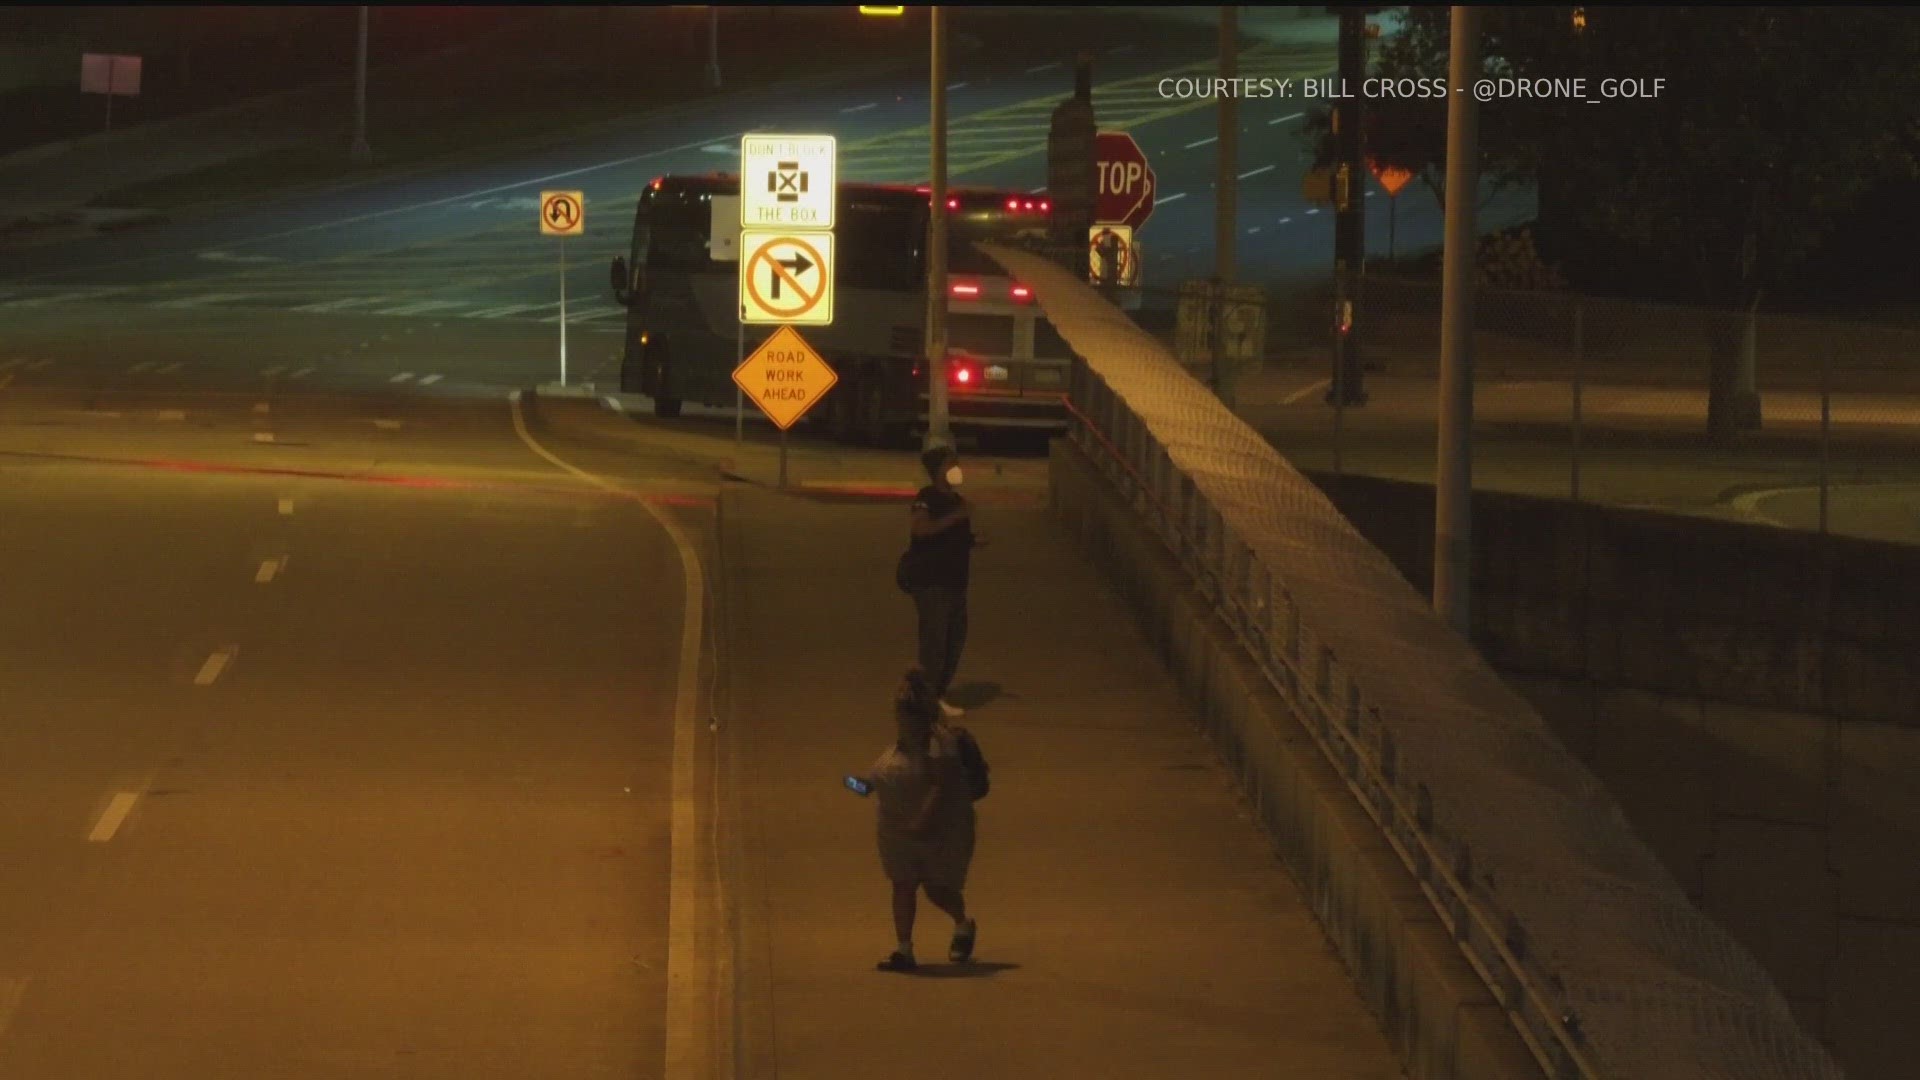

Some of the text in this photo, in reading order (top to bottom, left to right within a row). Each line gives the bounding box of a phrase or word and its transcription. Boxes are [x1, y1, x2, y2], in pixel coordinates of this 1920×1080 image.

[1096, 161, 1142, 195] TOP
[758, 207, 818, 222] THE BOX
[766, 350, 806, 364] ROAD
[765, 369, 804, 382] WORK
[762, 388, 807, 401] AHEAD
